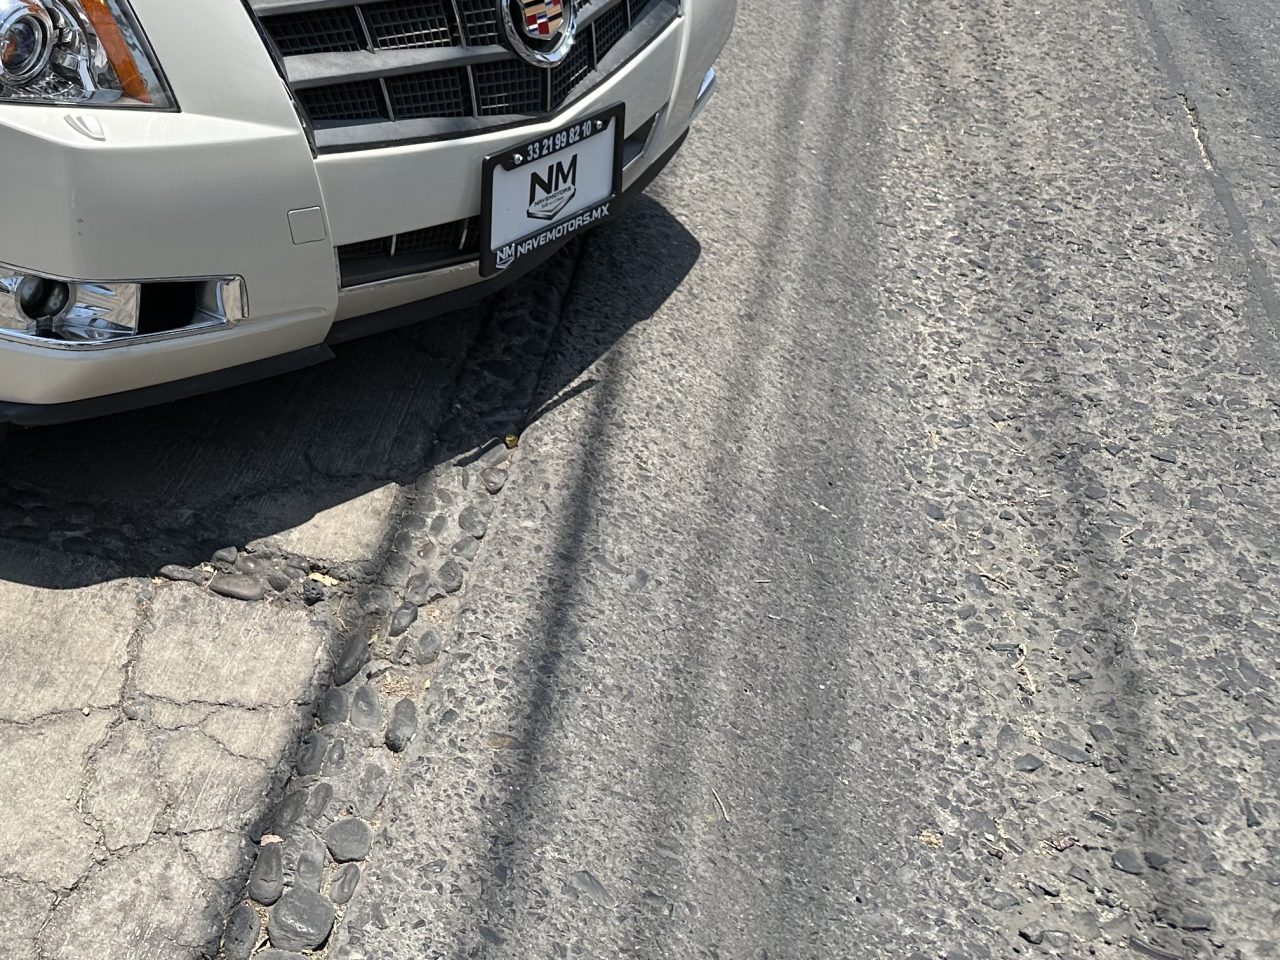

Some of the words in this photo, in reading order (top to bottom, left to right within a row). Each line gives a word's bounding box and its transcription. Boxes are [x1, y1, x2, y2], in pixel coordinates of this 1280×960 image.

[526, 142, 540, 161] 33
[542, 136, 554, 156] 21
[555, 130, 567, 150] 99
[569, 125, 580, 144] 82
[581, 120, 592, 137] 10
[529, 153, 578, 207] NM
[496, 243, 516, 264] NM
[516, 203, 610, 258] NAVEMOTORS.MX
